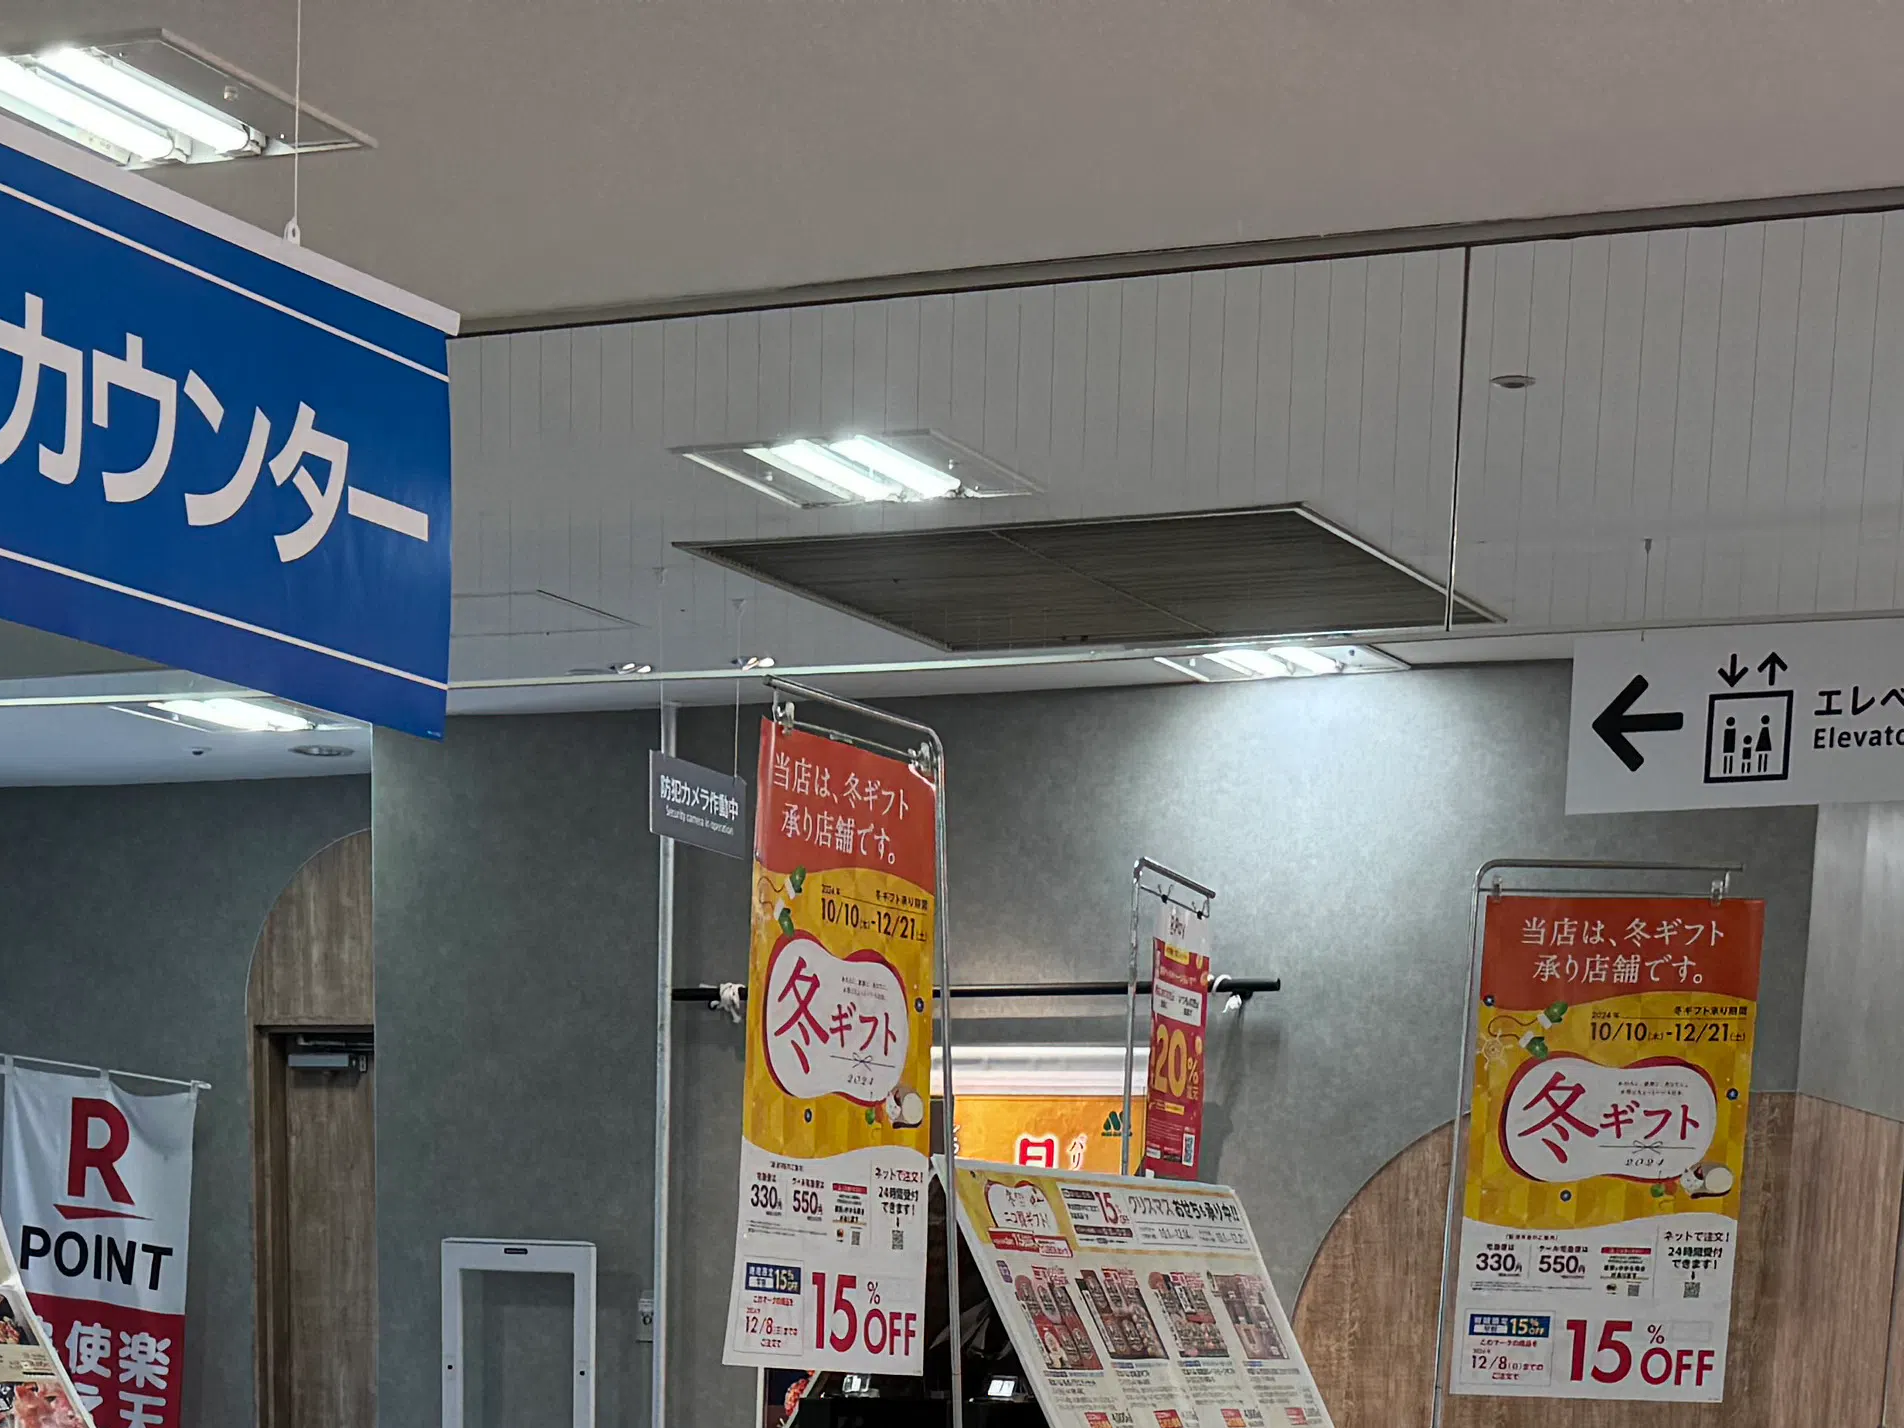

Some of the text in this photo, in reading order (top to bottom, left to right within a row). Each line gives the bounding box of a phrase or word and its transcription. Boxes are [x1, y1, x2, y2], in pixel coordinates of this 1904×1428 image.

[660, 774, 739, 821] 防犯カメラ作動中
[772, 750, 911, 822] 当店は、冬ギフト
[780, 801, 896, 866] 承り店舗です。
[1520, 916, 1725, 948] 当店は、冬ギフト
[1531, 954, 1705, 985] 承り店舗です。
[773, 955, 898, 1077] 冬ギフト
[1673, 1005, 1749, 1018] 冬ギフト承り期間
[1517, 1070, 1701, 1164] 冬ギフト
[66, 1096, 136, 1206] R
[18, 1224, 174, 1291] POINT
[1662, 1231, 1731, 1244] ネットで注文！
[1667, 1246, 1723, 1259] 24時間受付
[1671, 1258, 1719, 1270] できます！
[863, 1308, 918, 1357] OFF
[1639, 1347, 1716, 1388] OFF
